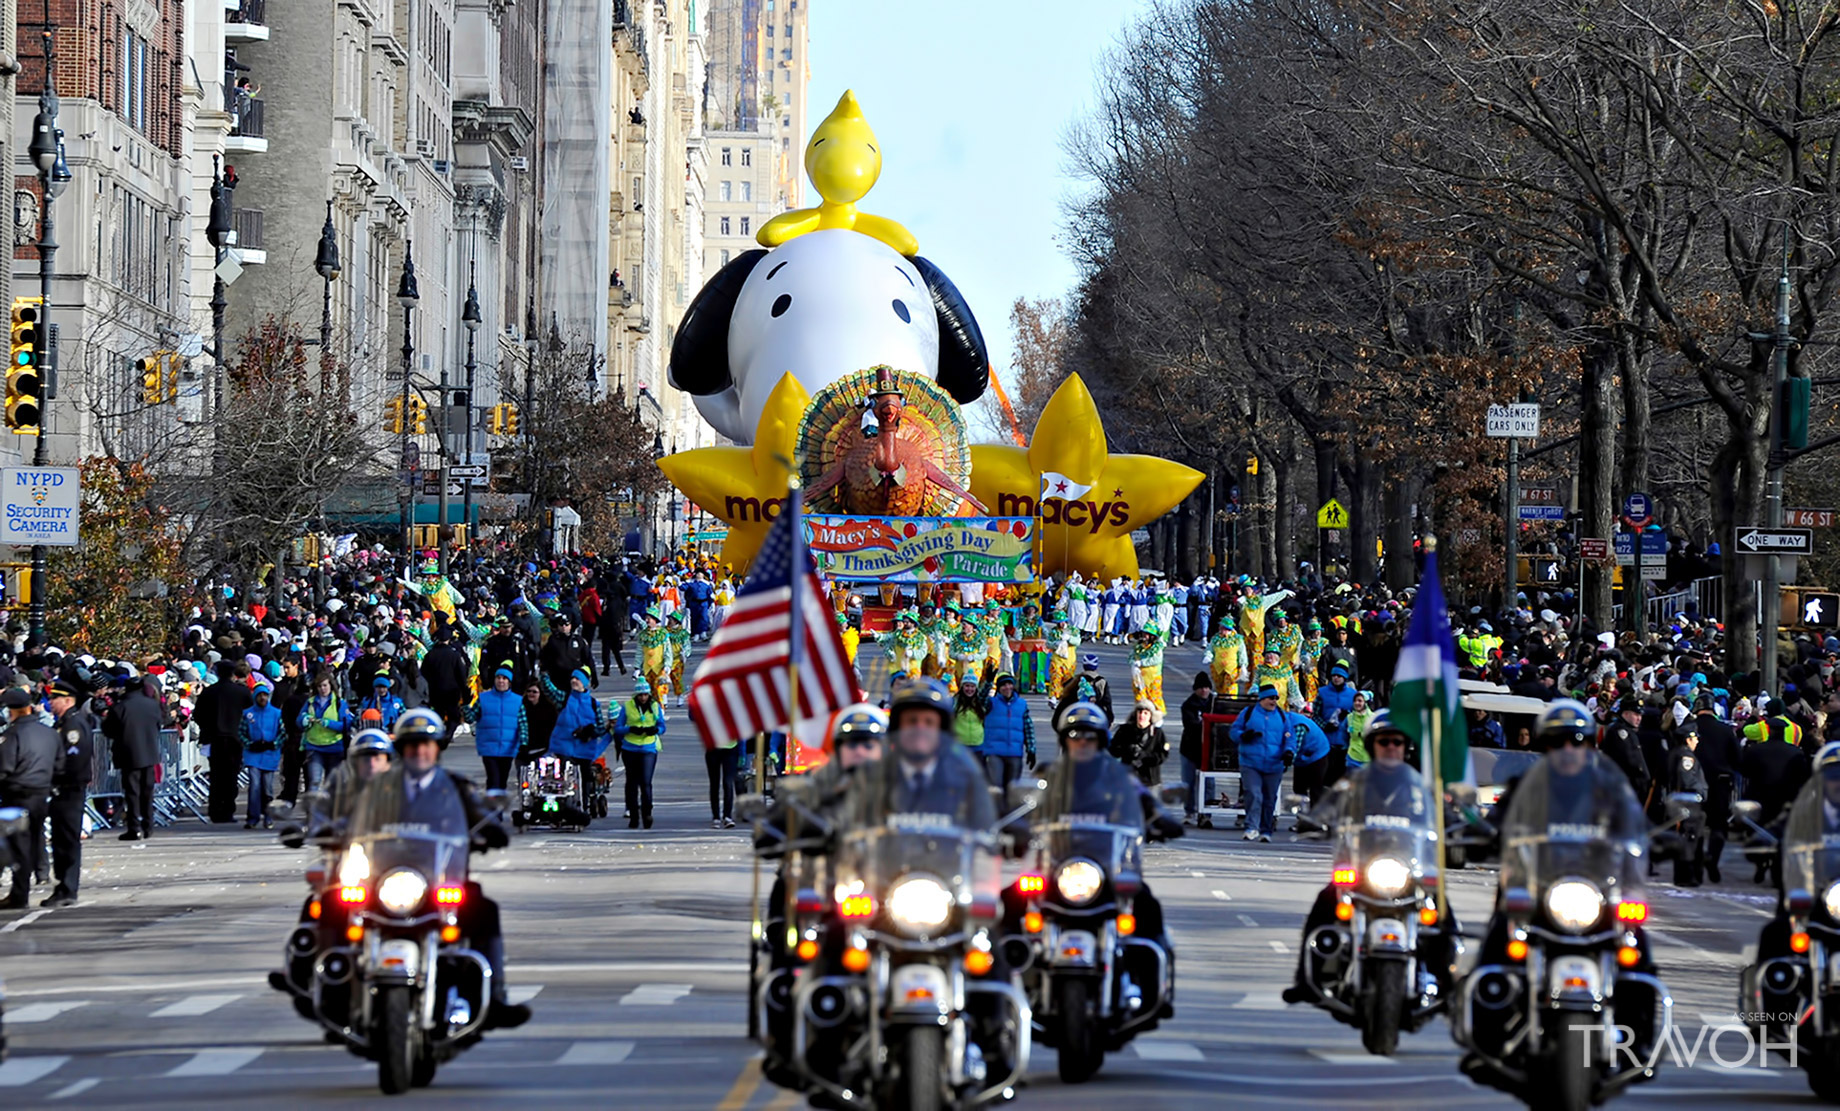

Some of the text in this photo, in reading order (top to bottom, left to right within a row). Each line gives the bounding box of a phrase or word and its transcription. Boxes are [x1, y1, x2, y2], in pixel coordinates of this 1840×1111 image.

[1489, 408, 1537, 418] PASSENGER
[1489, 420, 1536, 431] CARS ONLY
[16, 472, 64, 487] NYPD
[1521, 489, 1553, 500] W 67 ST
[6, 503, 72, 518] SECURITY
[8, 518, 68, 532] CAMERA
[1786, 511, 1832, 526] W 66 ST
[819, 525, 881, 546] Macy's
[1616, 534, 1631, 542] M10
[1747, 535, 1802, 545] ONE WAY
[842, 531, 995, 571] Thanksgiving Day
[1616, 545, 1632, 553] M72
[953, 553, 1008, 577] Parade
